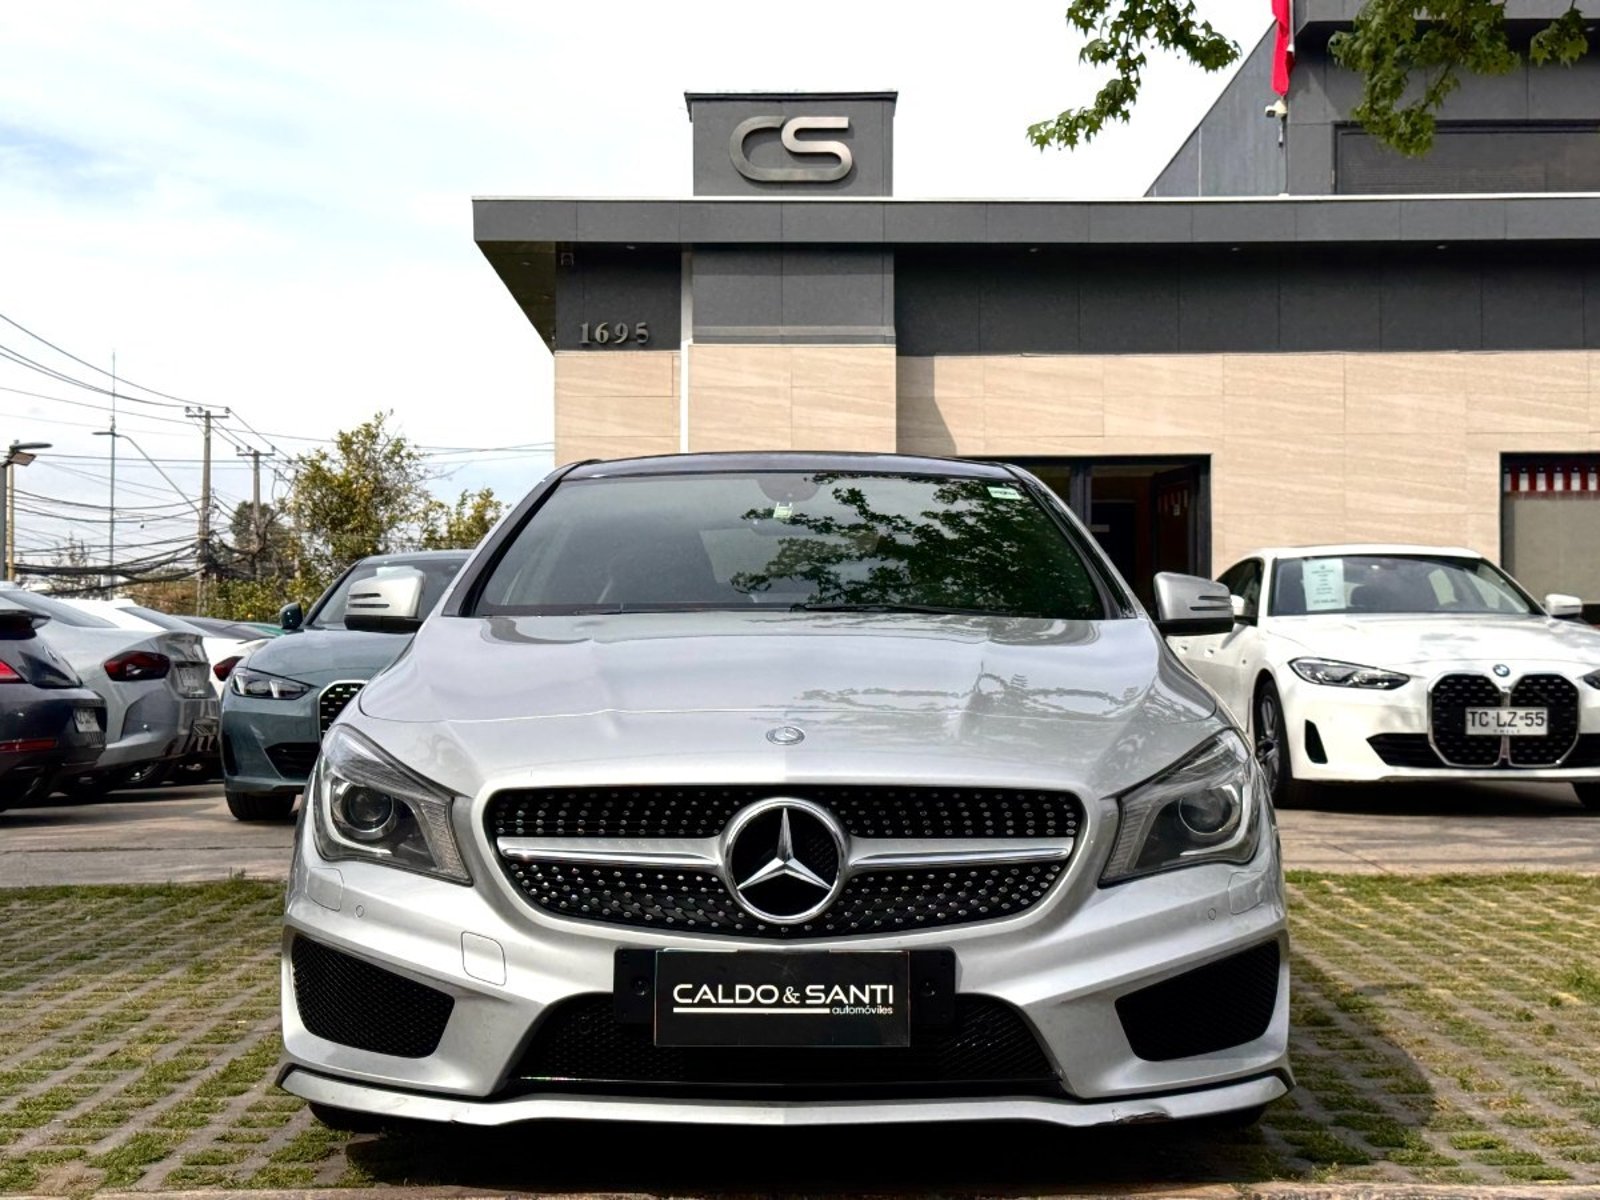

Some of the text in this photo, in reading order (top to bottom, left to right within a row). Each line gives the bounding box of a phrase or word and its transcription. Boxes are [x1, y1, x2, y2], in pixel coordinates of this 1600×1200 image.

[729, 115, 853, 181] CS
[578, 322, 649, 344] 1695
[831, 1005, 893, 1015] automóviles
